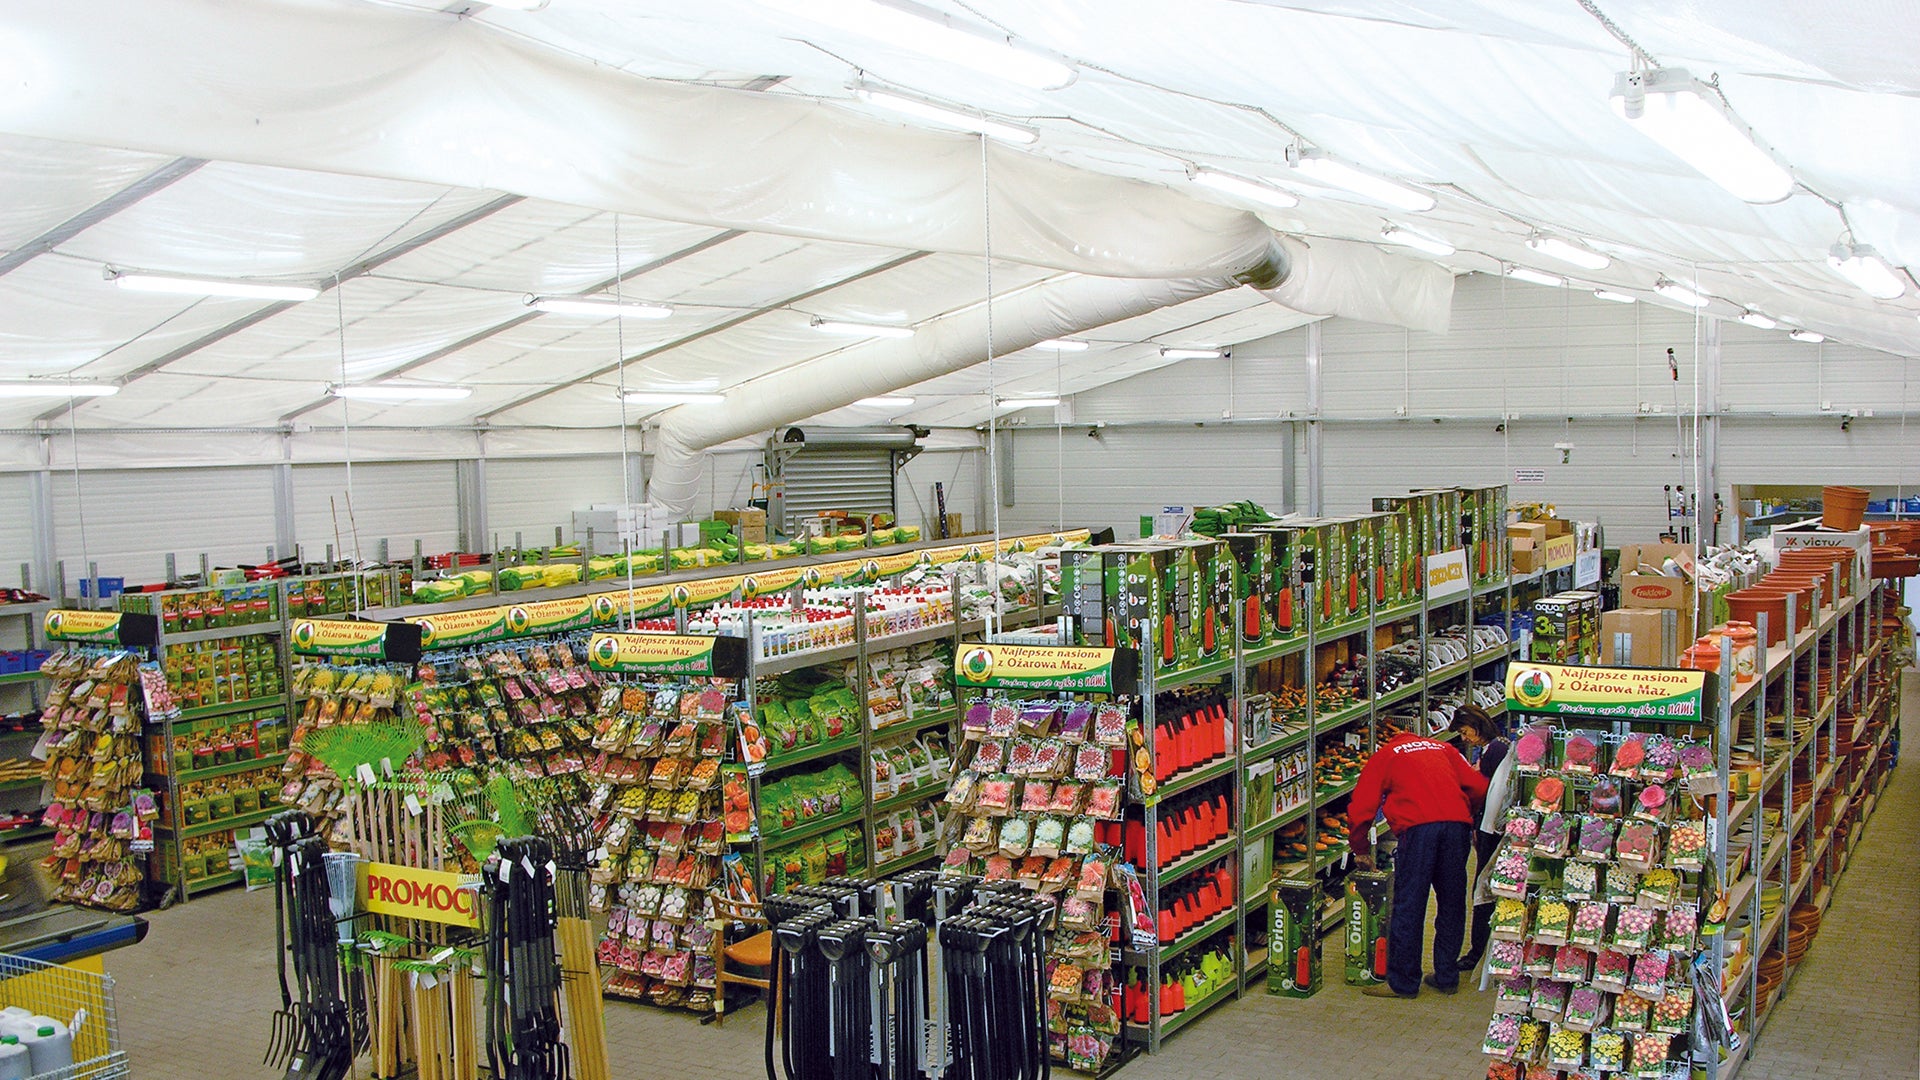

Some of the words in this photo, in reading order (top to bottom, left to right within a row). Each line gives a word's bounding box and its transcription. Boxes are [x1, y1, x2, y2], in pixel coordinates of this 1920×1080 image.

[624, 636, 666, 646] Najlepsze
[630, 646, 669, 656] Ożarowa
[671, 648, 692, 656] Maz.
[1000, 647, 1053, 658] Najlepsze
[1007, 658, 1057, 669] Ożarowa
[1060, 660, 1087, 670] Maz.
[1561, 668, 1628, 681] Najlepsze
[1633, 674, 1688, 684] nasiona
[1570, 681, 1632, 694] Ożarowa
[1637, 684, 1670, 696] Maz.
[1668, 697, 1695, 716] nami
[1350, 901, 1361, 944] Orion
[1272, 909, 1284, 953] Orion
